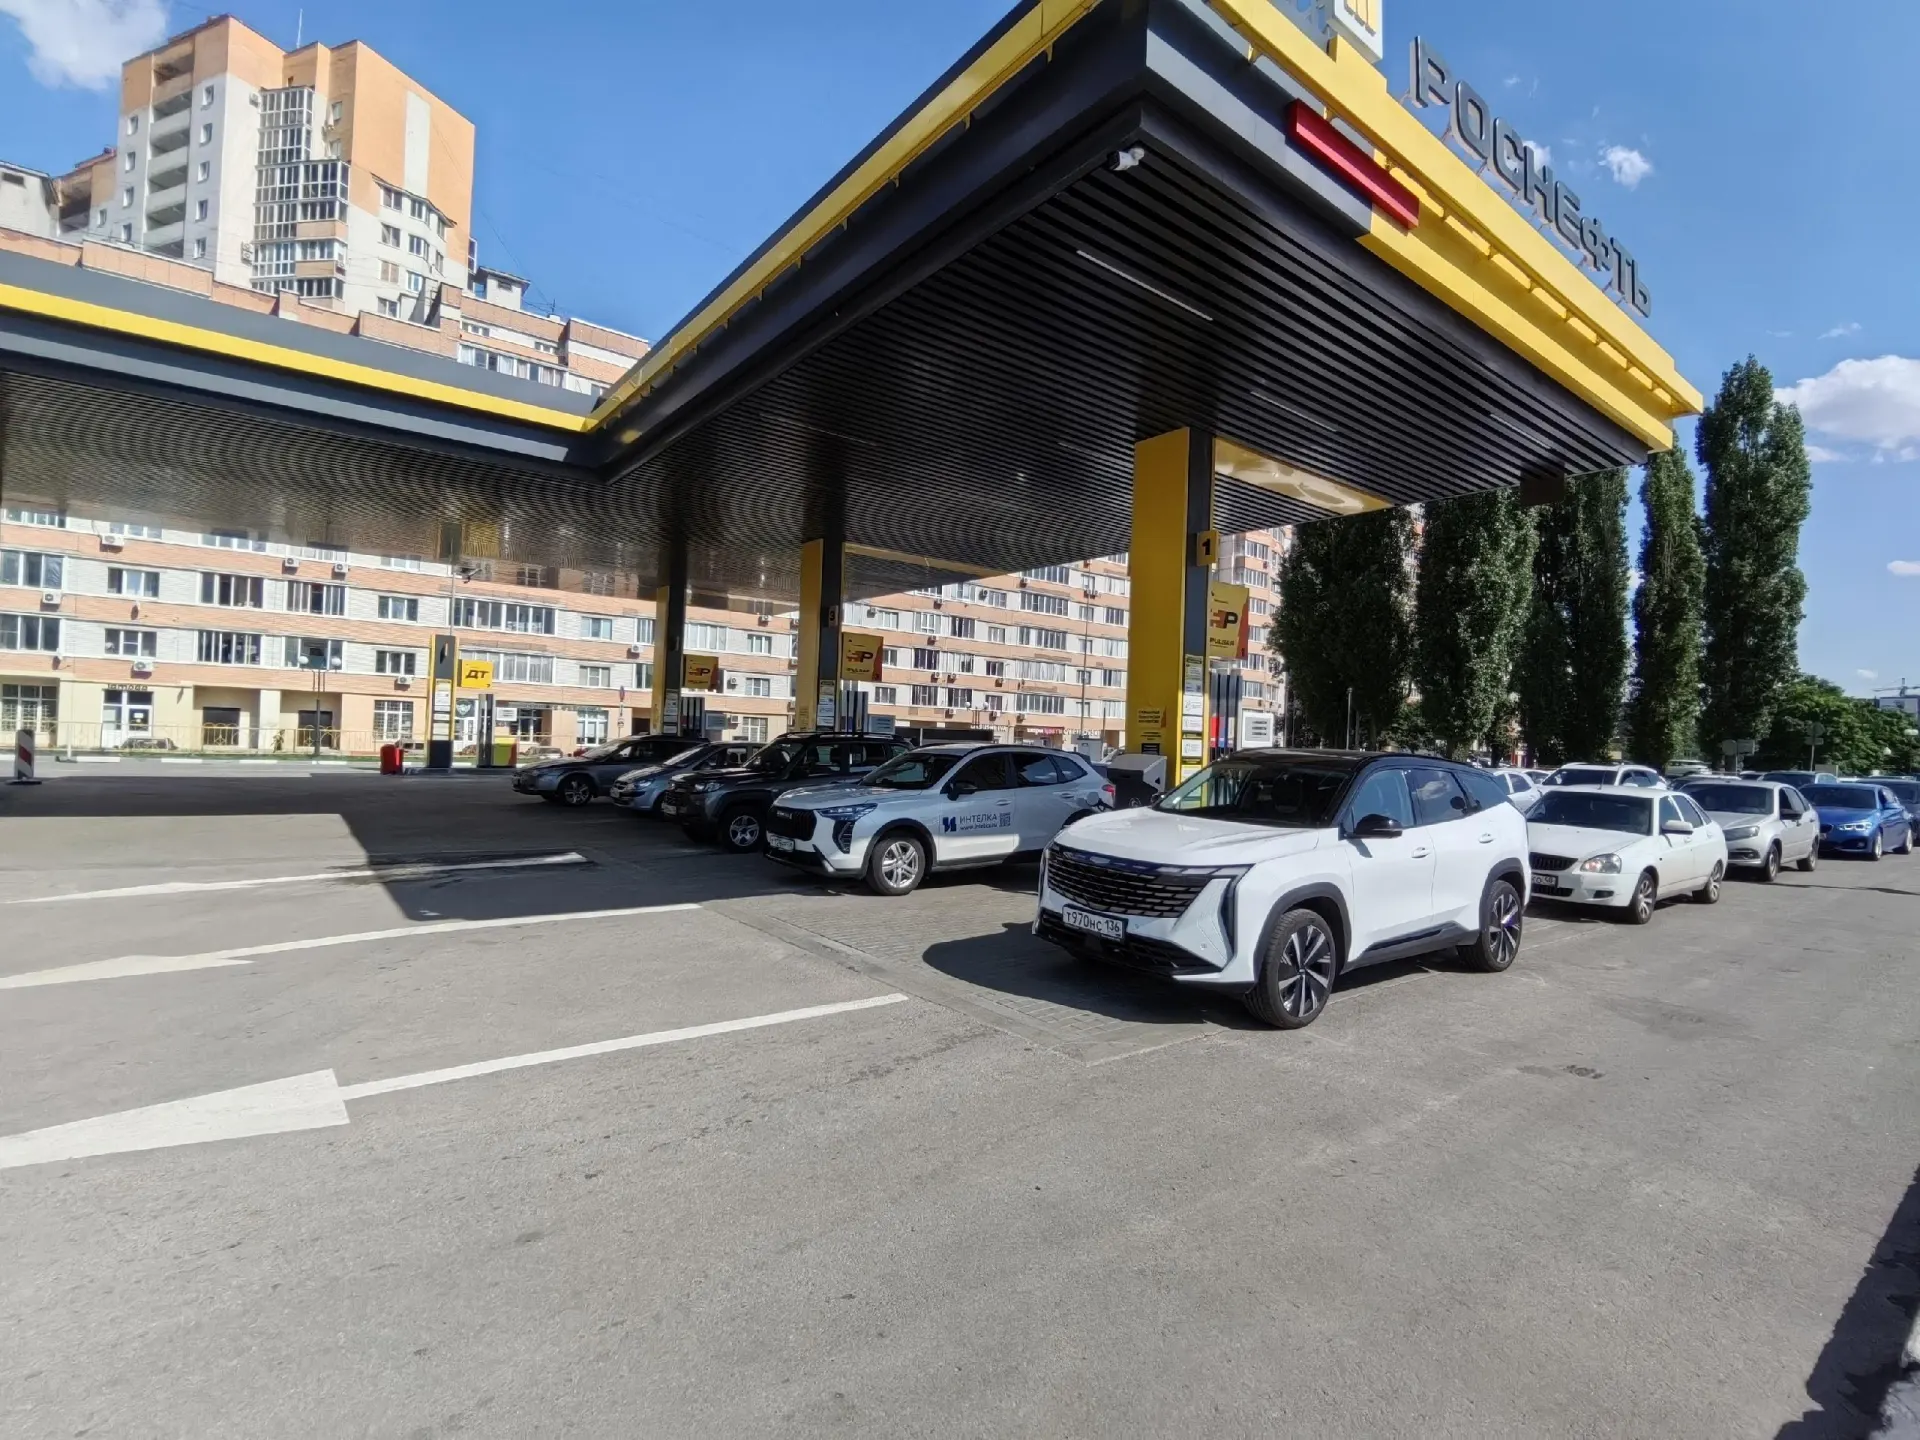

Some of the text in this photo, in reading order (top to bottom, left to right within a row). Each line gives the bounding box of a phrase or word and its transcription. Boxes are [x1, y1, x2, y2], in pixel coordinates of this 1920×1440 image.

[1409, 35, 1651, 318] РОСНЕФТЬ
[1201, 538, 1210, 555] 1
[465, 669, 490, 679] ДТ
[959, 814, 998, 824] ИНТЕЛКА
[1066, 911, 1120, 933] Т970НС 136
